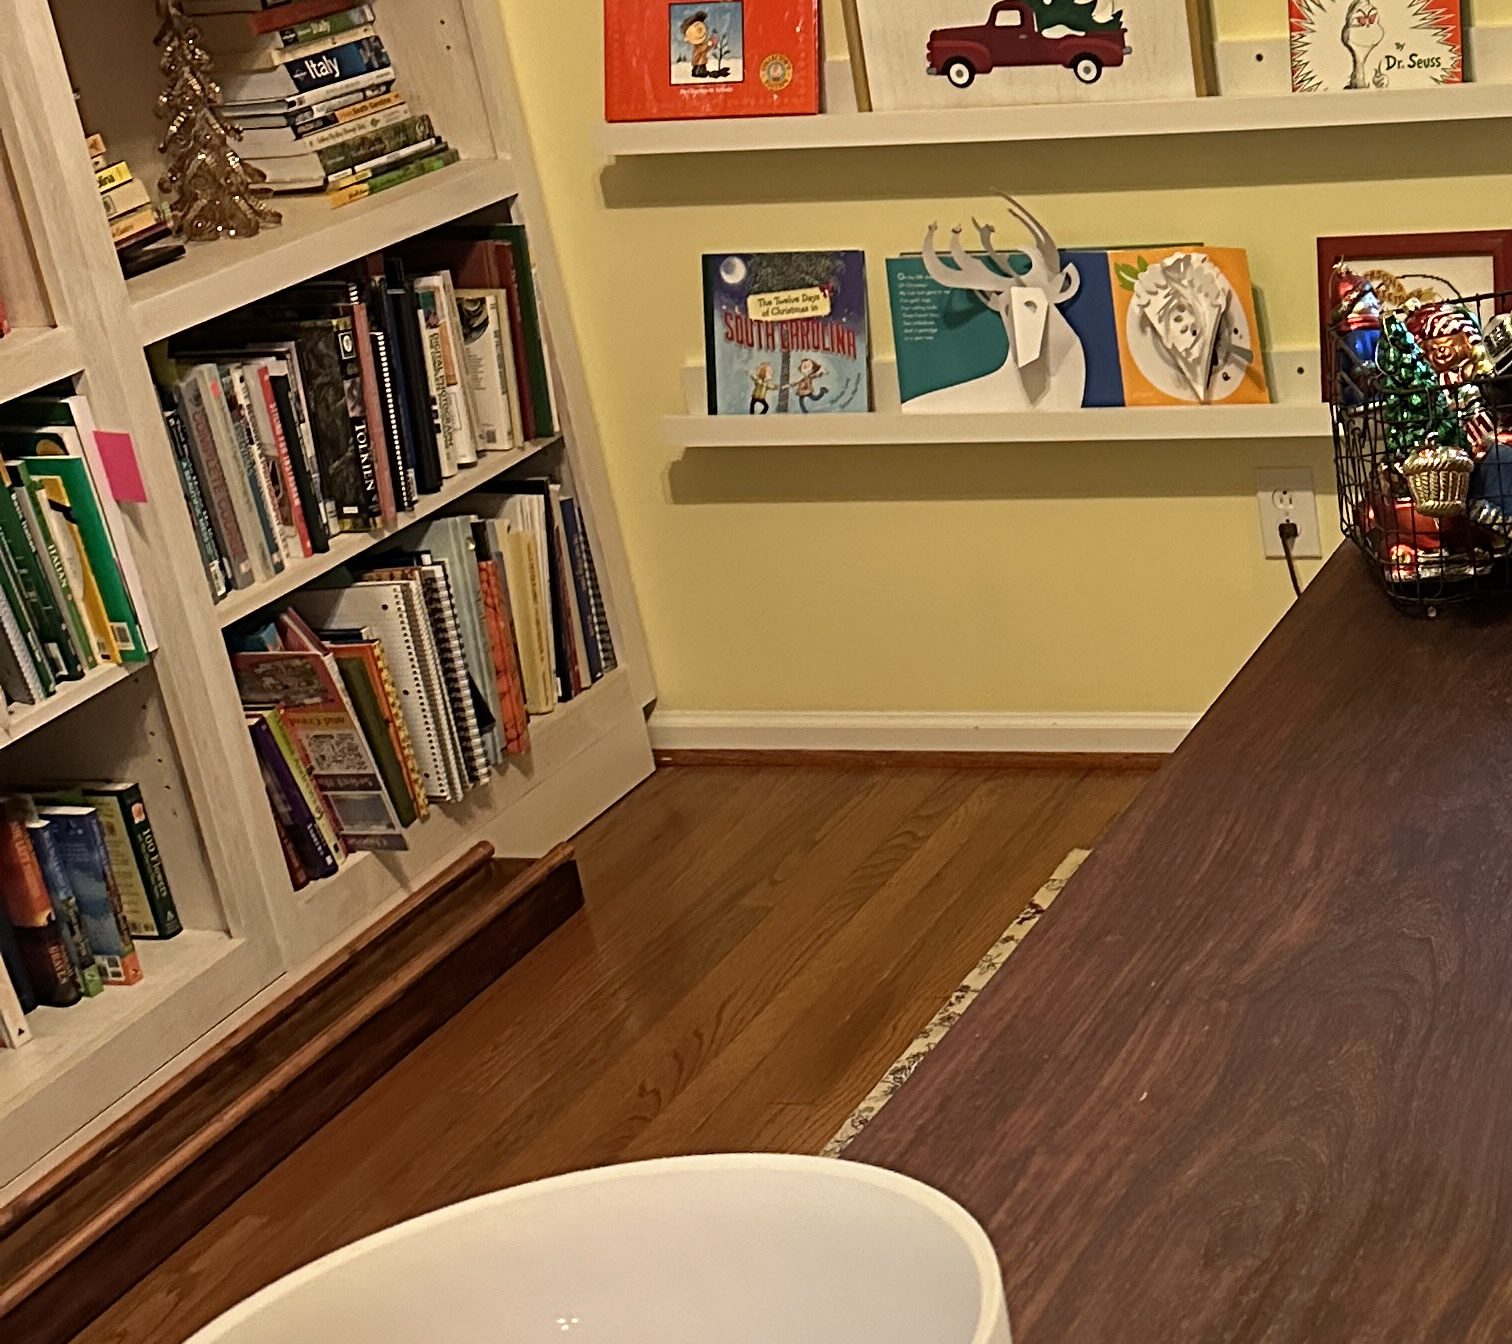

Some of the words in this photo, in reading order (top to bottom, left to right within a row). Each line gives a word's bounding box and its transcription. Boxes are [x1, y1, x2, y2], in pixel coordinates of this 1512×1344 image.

[311, 19, 331, 34] Italy
[305, 56, 339, 80] Italy
[1385, 55, 1405, 70] Dr.
[1407, 53, 1441, 69] Seuss
[757, 298, 772, 307] The
[774, 295, 799, 305] Twelve
[802, 293, 820, 304] Days
[762, 309, 769, 317] of
[771, 305, 809, 316] Christmas
[724, 310, 775, 351] SOUTH
[781, 317, 856, 360] CAROLINA
[433, 332, 443, 370] DIGITAL
[353, 423, 375, 492] TOLKIEN
[46, 543, 69, 588] ITALIAN
